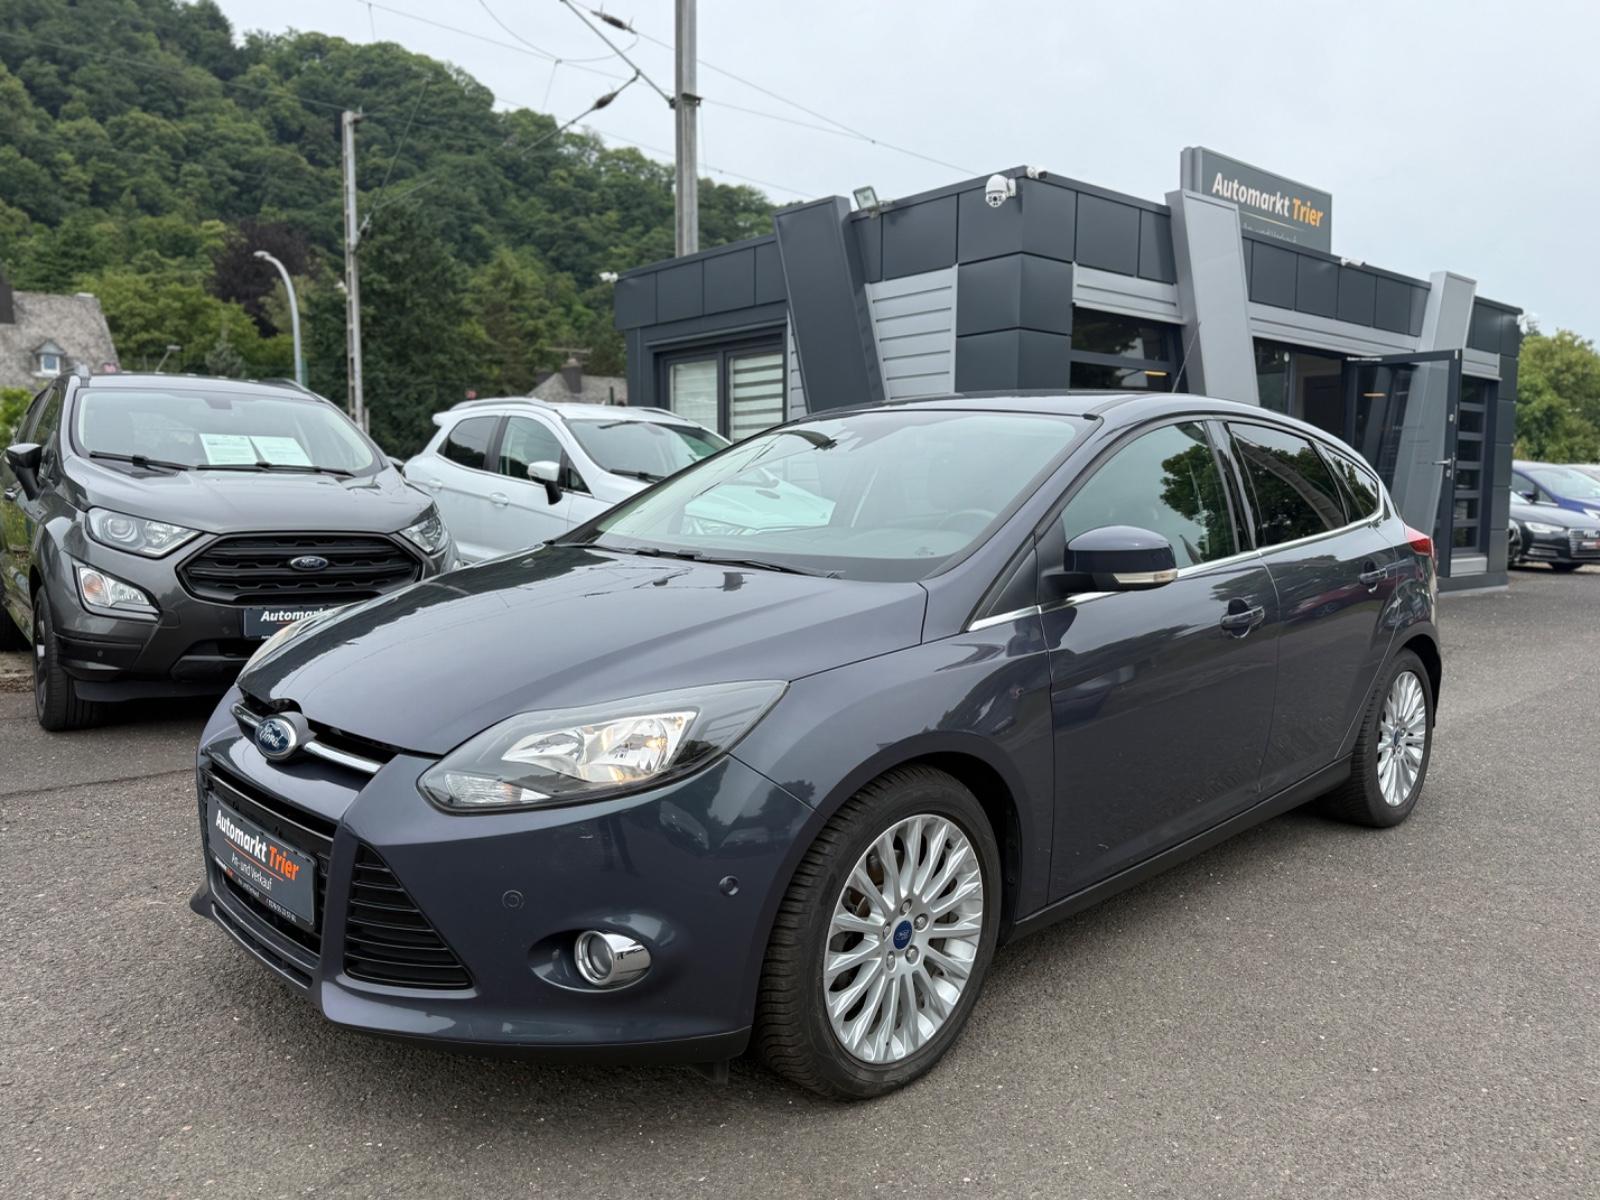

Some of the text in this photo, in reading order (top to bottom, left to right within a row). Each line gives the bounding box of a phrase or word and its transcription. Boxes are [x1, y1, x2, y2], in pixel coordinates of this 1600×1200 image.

[1212, 172, 1324, 227] Automarkt Trier
[215, 809, 267, 863] Automarkt
[269, 846, 299, 881] Trier
[251, 866, 272, 890] Verkauf
